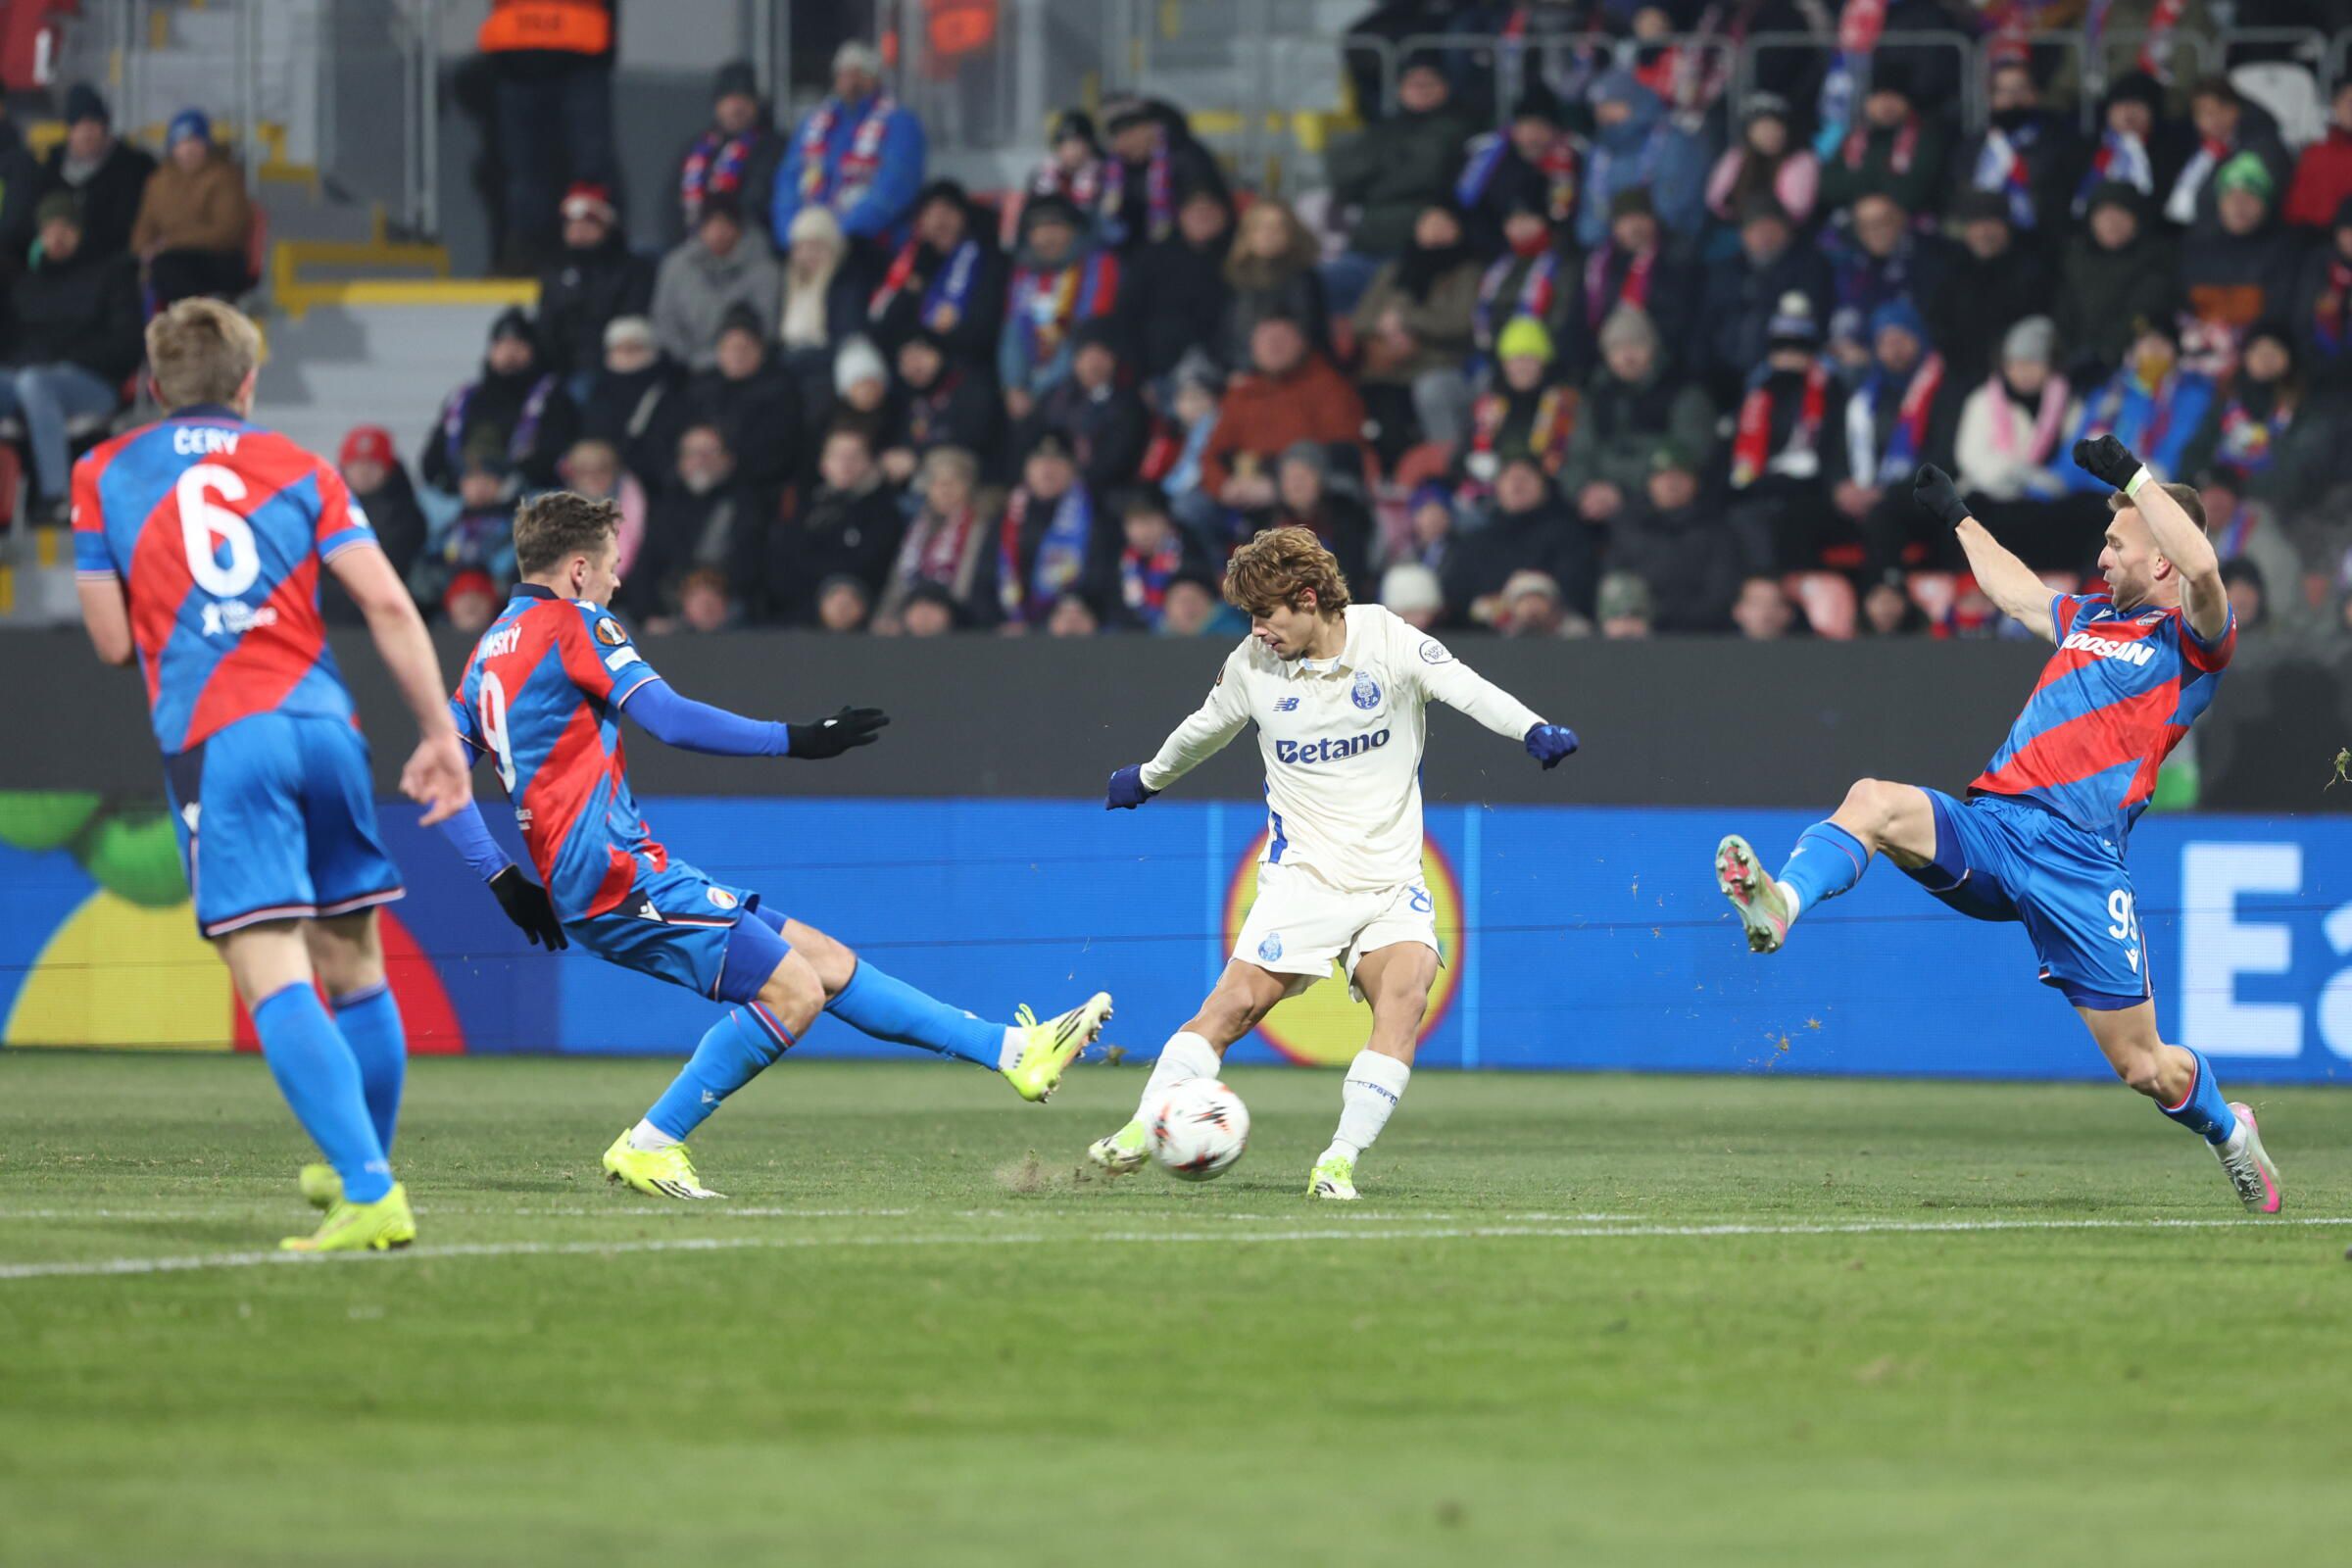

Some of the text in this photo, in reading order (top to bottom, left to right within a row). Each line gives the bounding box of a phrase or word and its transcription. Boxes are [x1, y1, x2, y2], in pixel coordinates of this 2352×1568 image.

[175, 464, 261, 598] 6
[479, 670, 516, 793] 9
[1276, 728, 1391, 764] Betano
